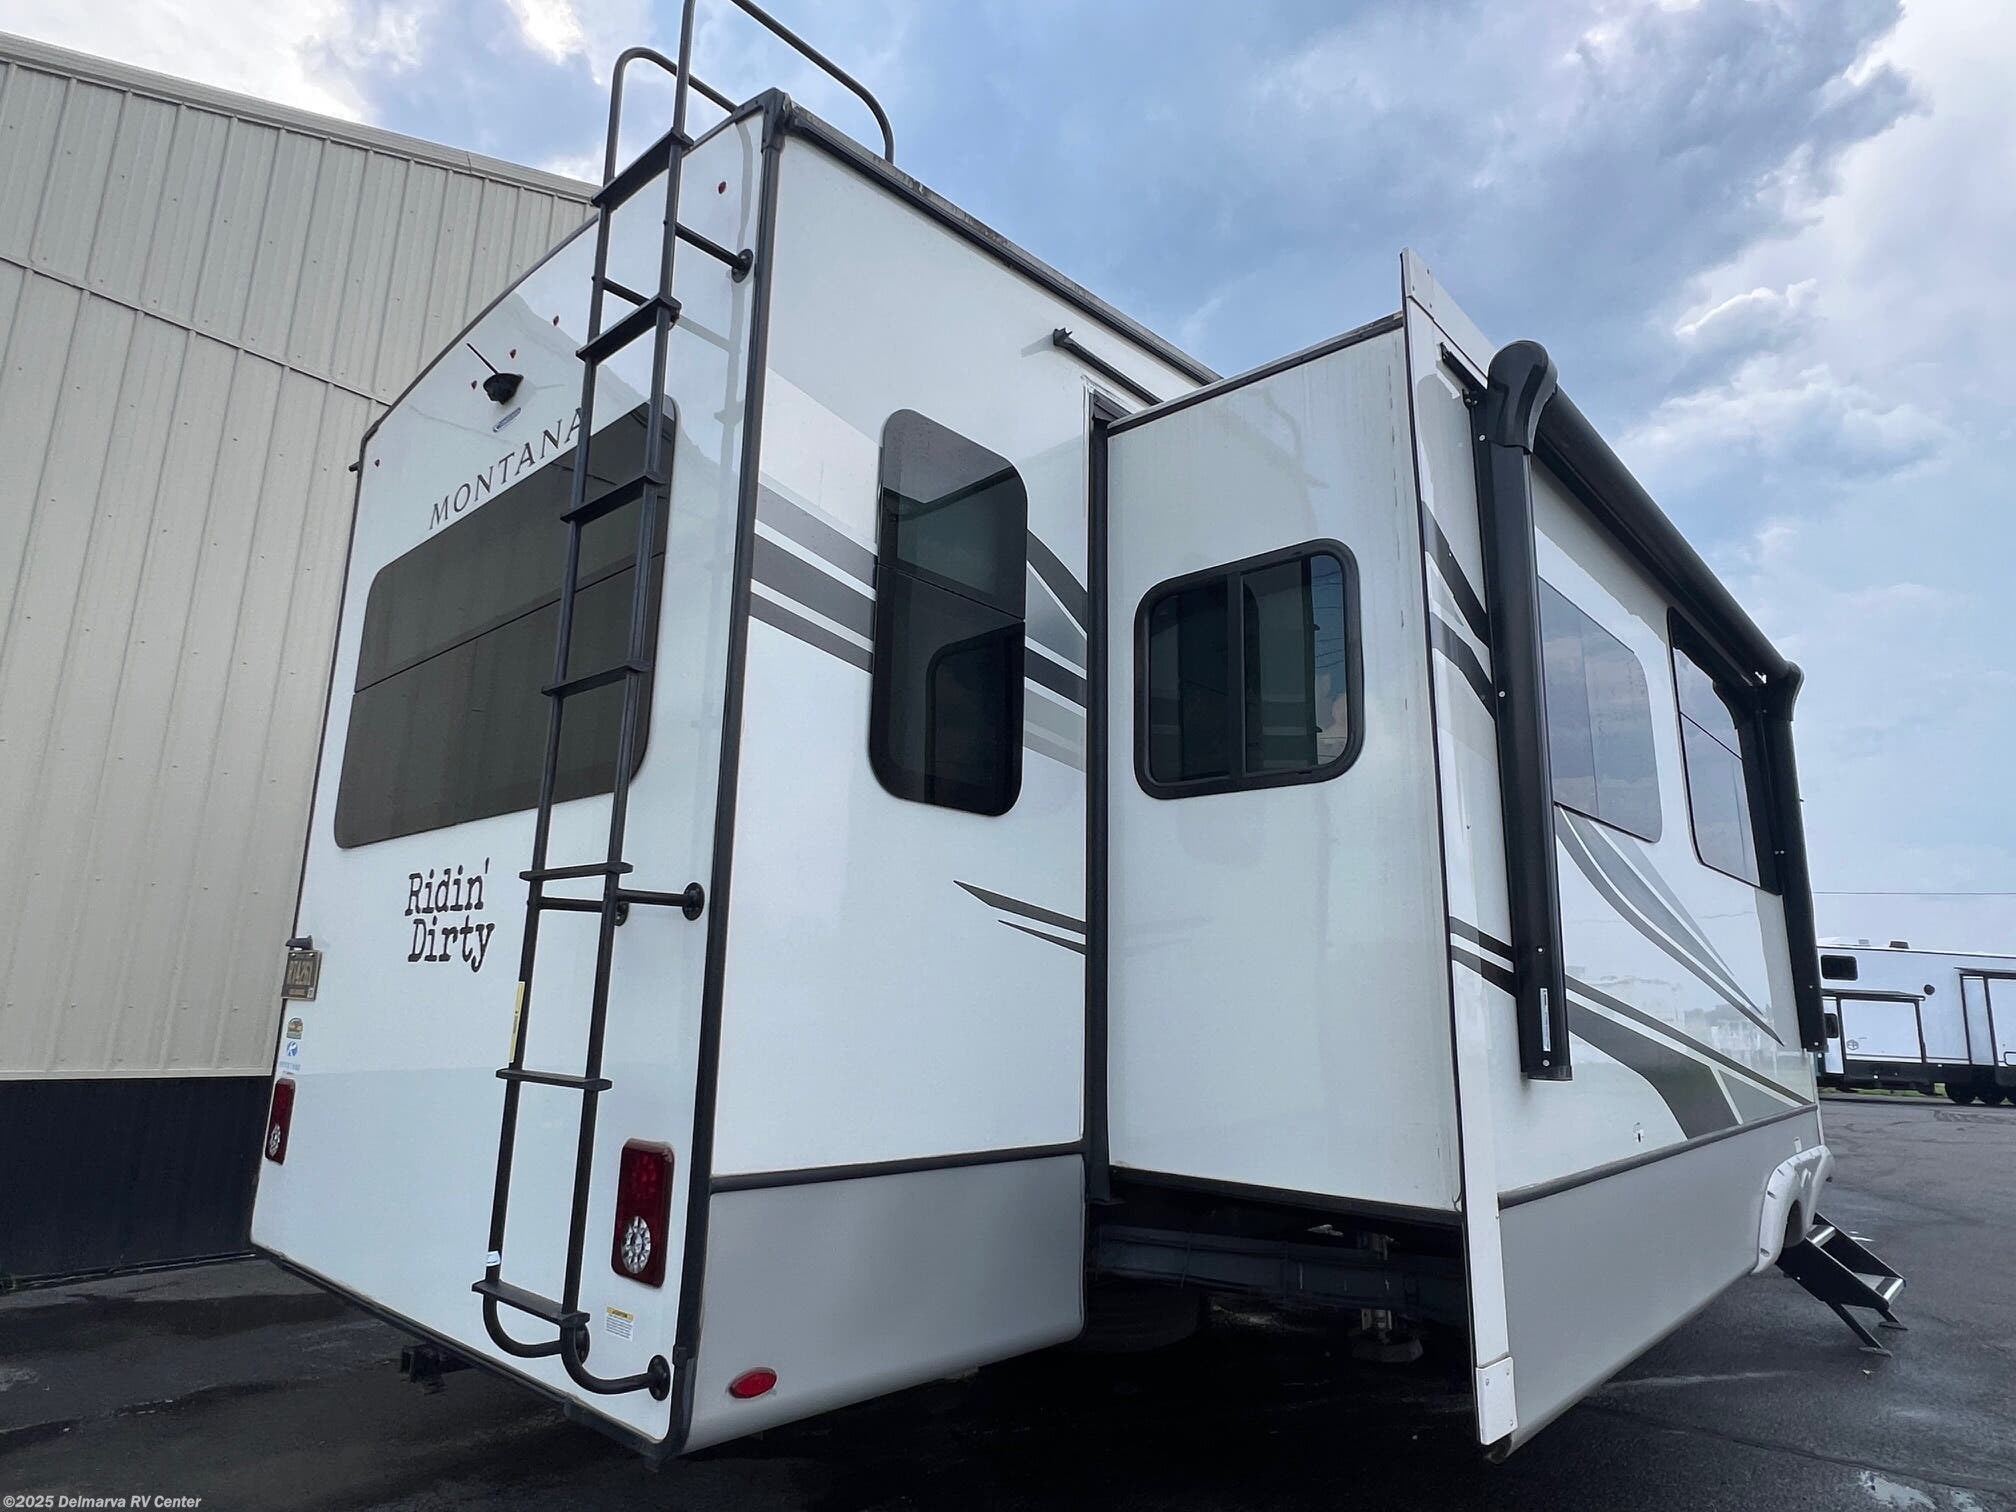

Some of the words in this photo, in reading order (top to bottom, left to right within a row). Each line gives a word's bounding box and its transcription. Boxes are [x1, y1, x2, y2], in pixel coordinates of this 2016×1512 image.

[428, 407, 582, 531] MONTANA
[405, 857, 490, 916] Ridin'
[408, 915, 496, 973] Dirty
